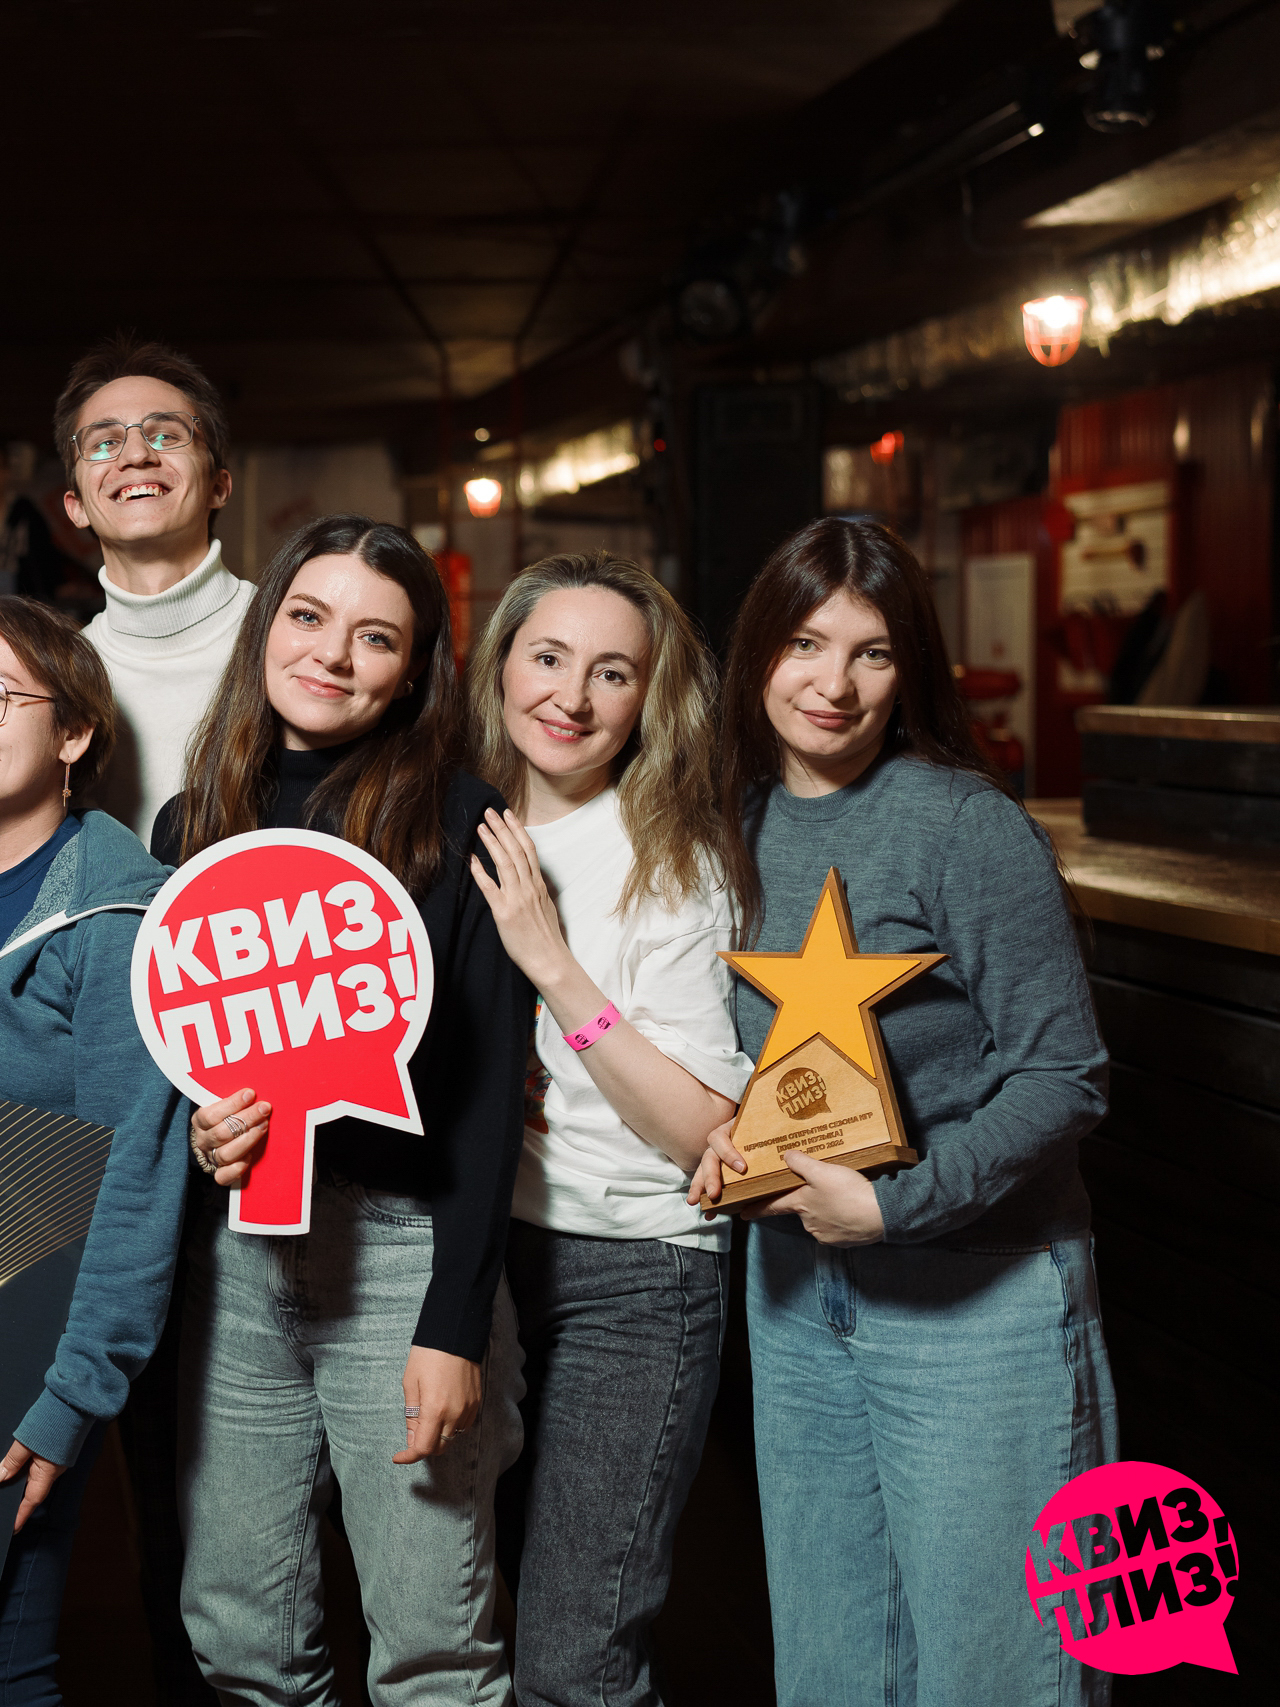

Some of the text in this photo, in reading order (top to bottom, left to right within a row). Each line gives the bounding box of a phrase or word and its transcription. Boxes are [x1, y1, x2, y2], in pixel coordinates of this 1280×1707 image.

[150, 880, 411, 995] КВИЗ,
[158, 953, 418, 1073] ПЛИЗ!
[776, 1071, 822, 1103] КВИЗ,
[781, 1082, 827, 1116] ПЛИЗ!
[744, 1112, 873, 1152] ЦЕРЕМОНИЯ ОТКРЫТИЯ СЕЗОНА ИГР
[776, 1141, 800, 1153] [КИНО
[807, 1129, 843, 1145] МУЗЫКА]
[826, 1139, 845, 1149] 2026
